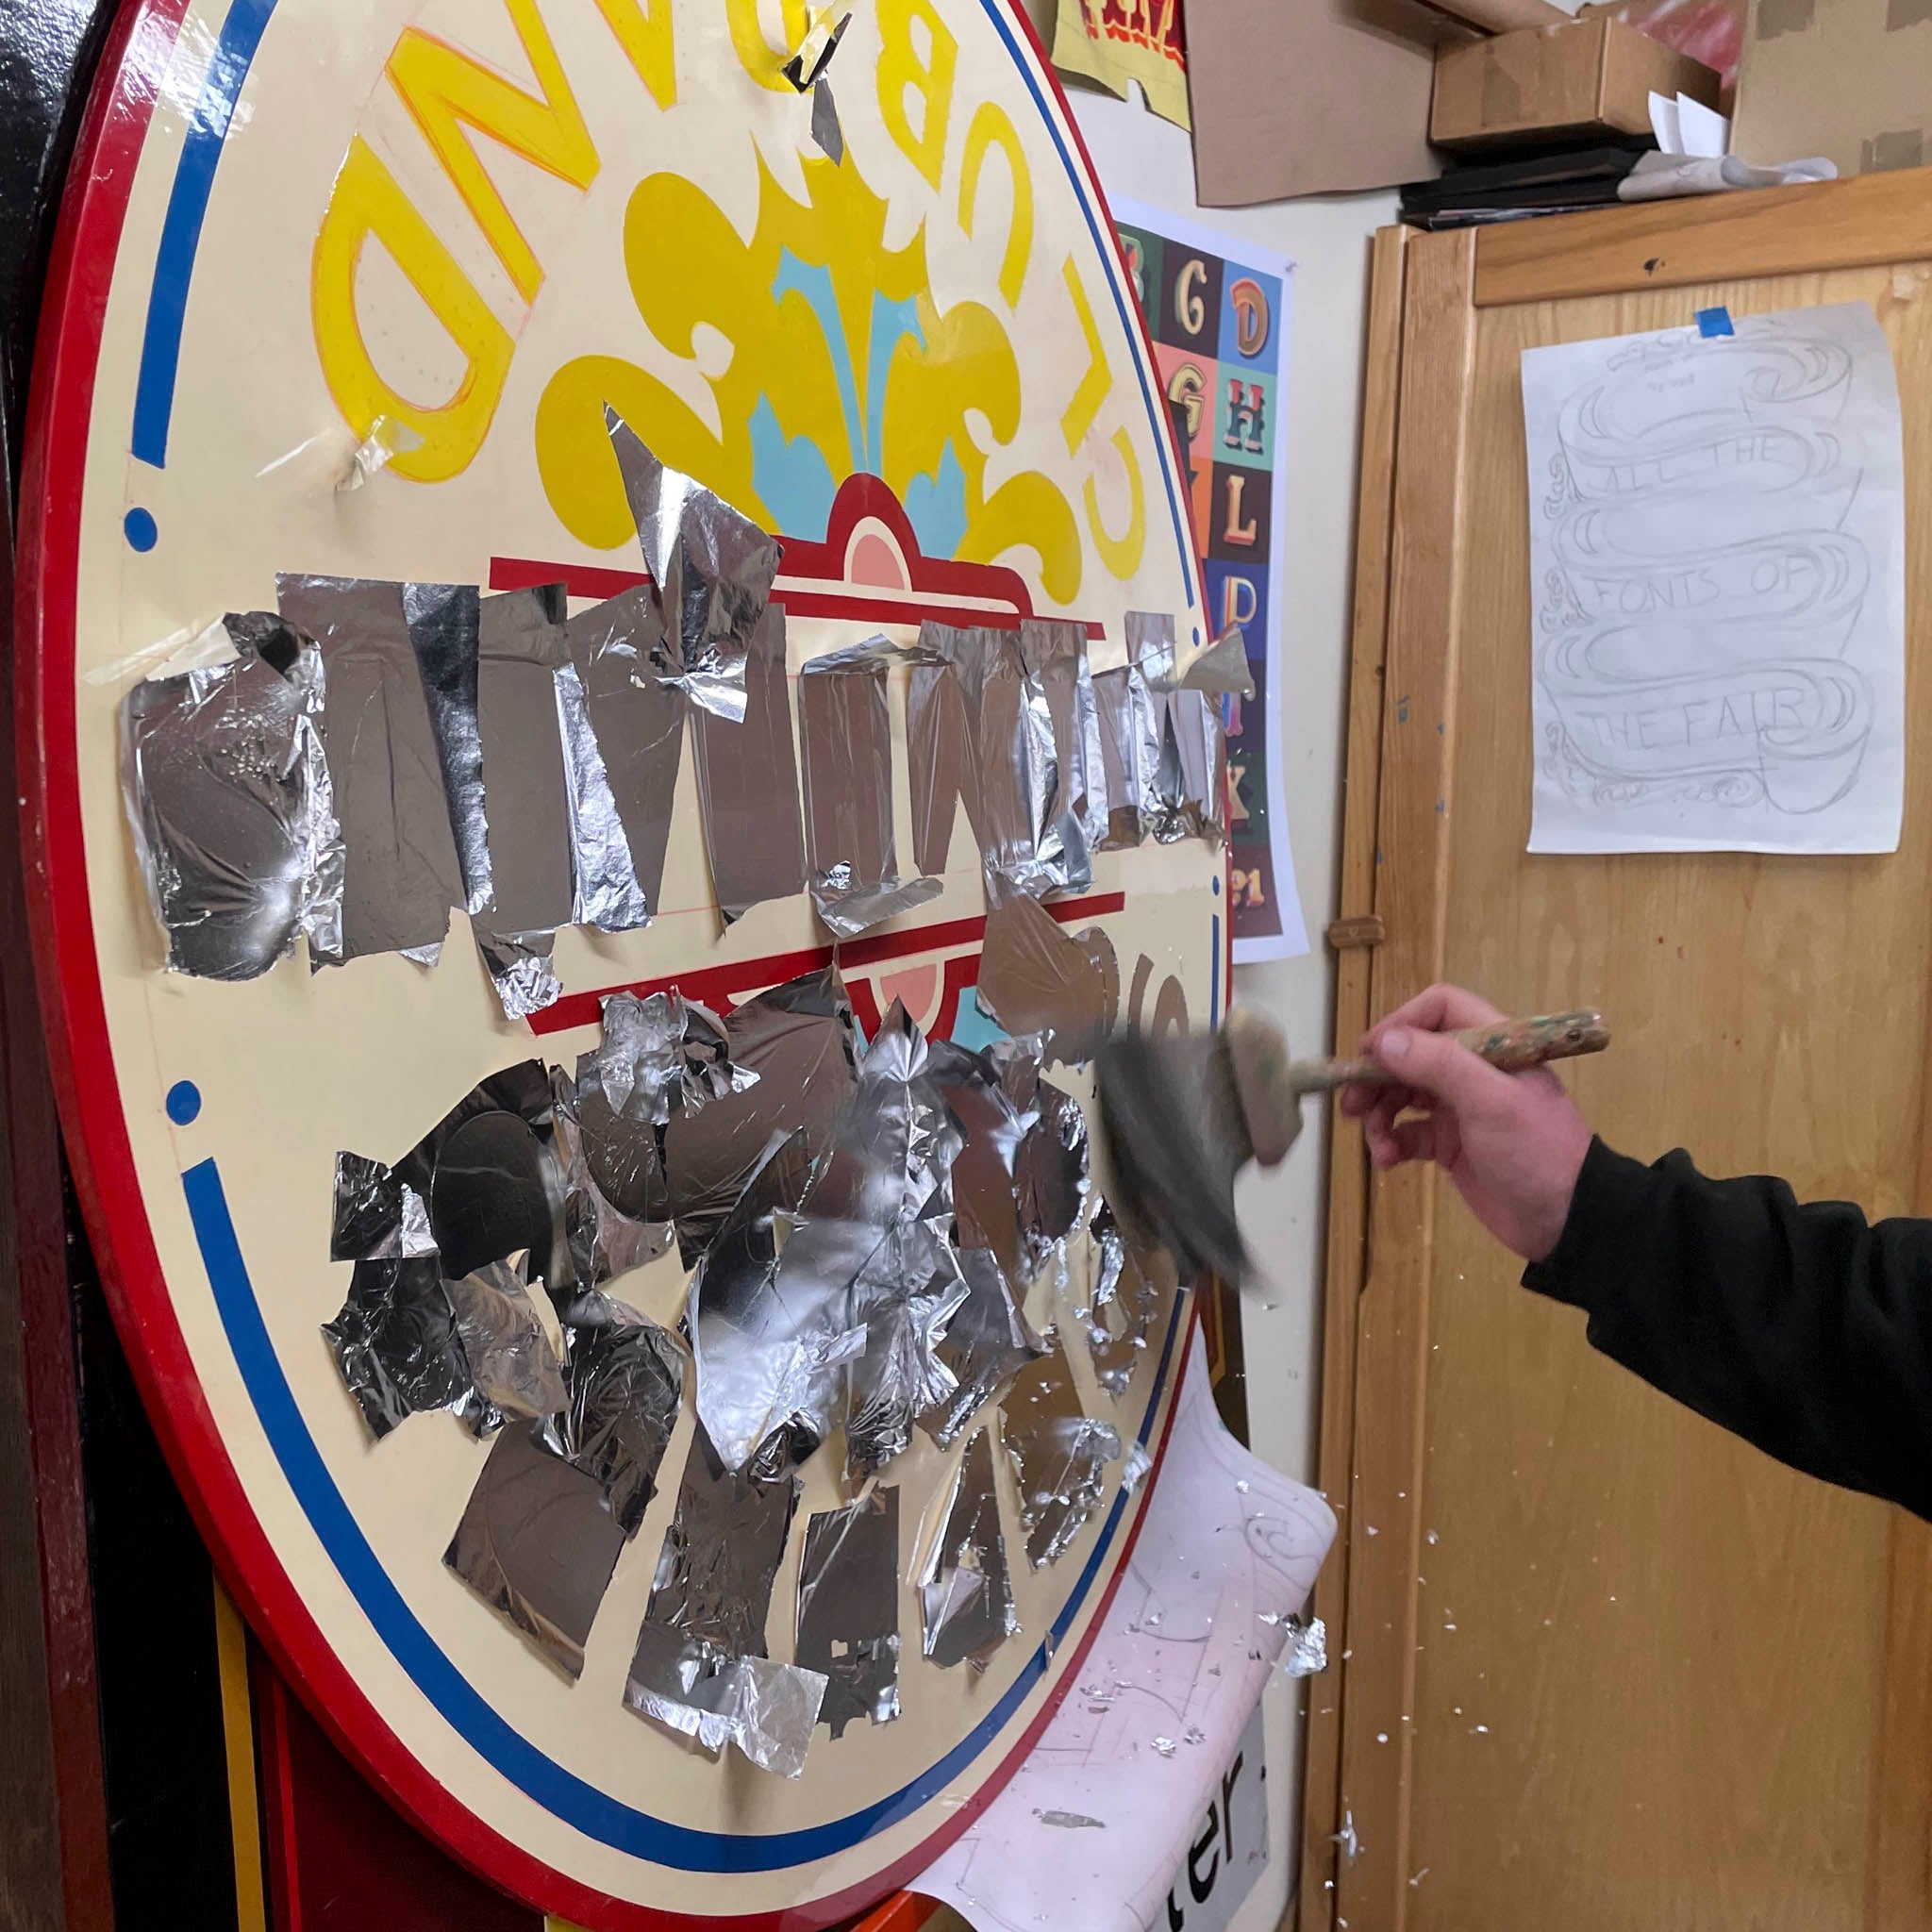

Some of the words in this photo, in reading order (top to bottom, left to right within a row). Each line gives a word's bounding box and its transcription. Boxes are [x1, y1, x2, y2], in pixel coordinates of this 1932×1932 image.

[1230, 277, 1270, 358] D
[1168, 362, 1208, 440] G
[1224, 378, 1265, 456] H
[1704, 433, 1783, 468] THE
[1224, 475, 1257, 546] L
[1591, 566, 1721, 613] FONTS
[1750, 554, 1812, 594] OF
[1577, 710, 1657, 751] THE
[1682, 687, 1805, 747] FAIR
